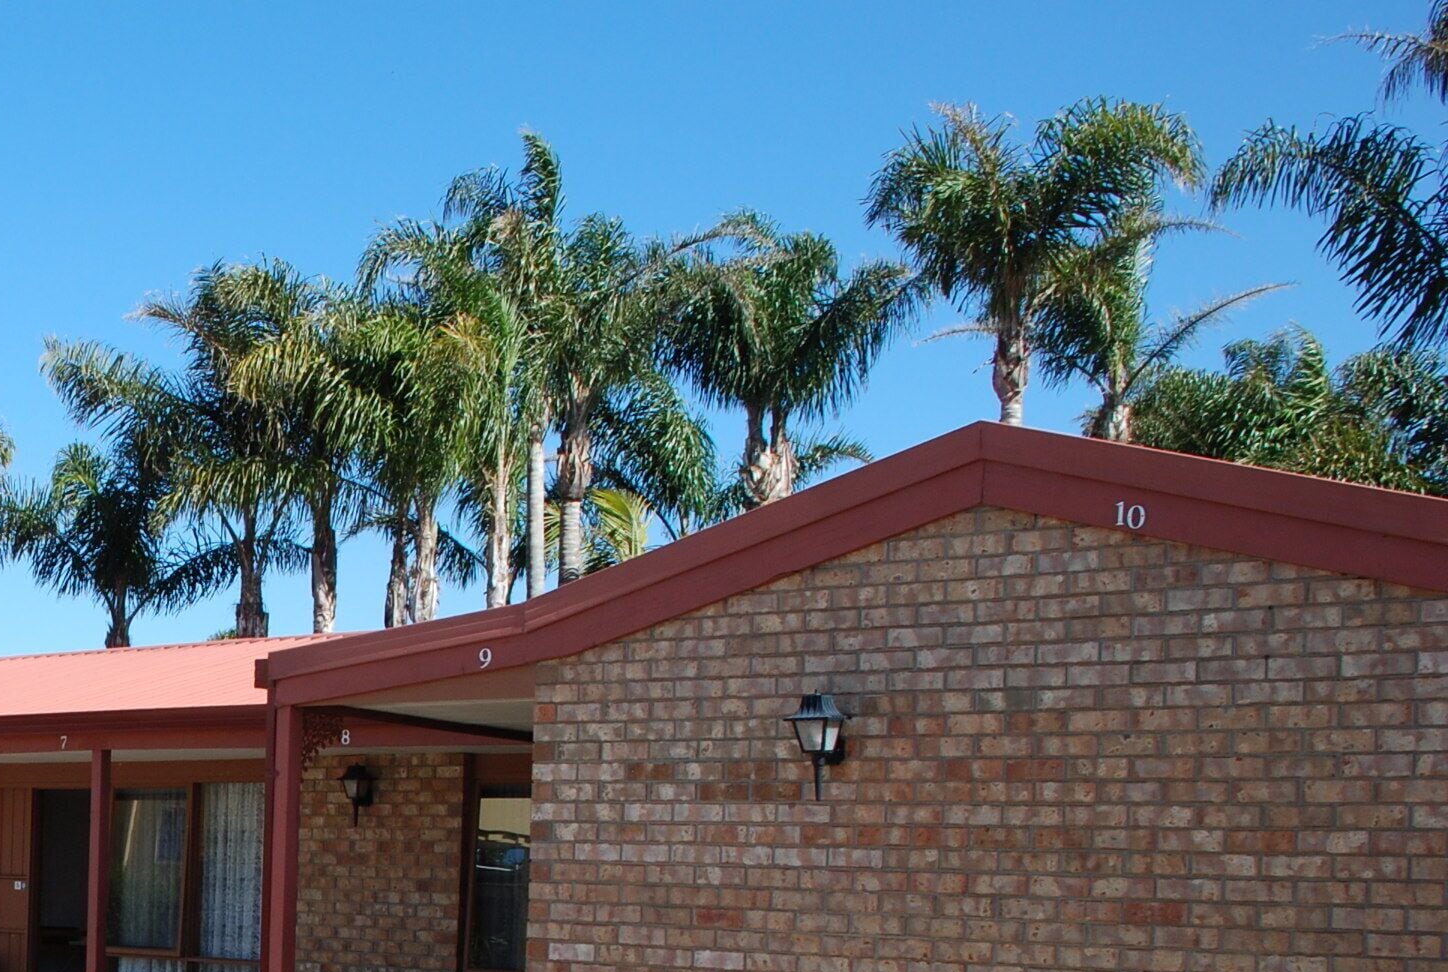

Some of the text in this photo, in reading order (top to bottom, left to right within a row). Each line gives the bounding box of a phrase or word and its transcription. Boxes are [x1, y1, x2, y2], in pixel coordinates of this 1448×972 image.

[1115, 501, 1145, 530] 10
[479, 648, 492, 669] 9
[60, 736, 68, 750] 7
[341, 729, 350, 745] 8
